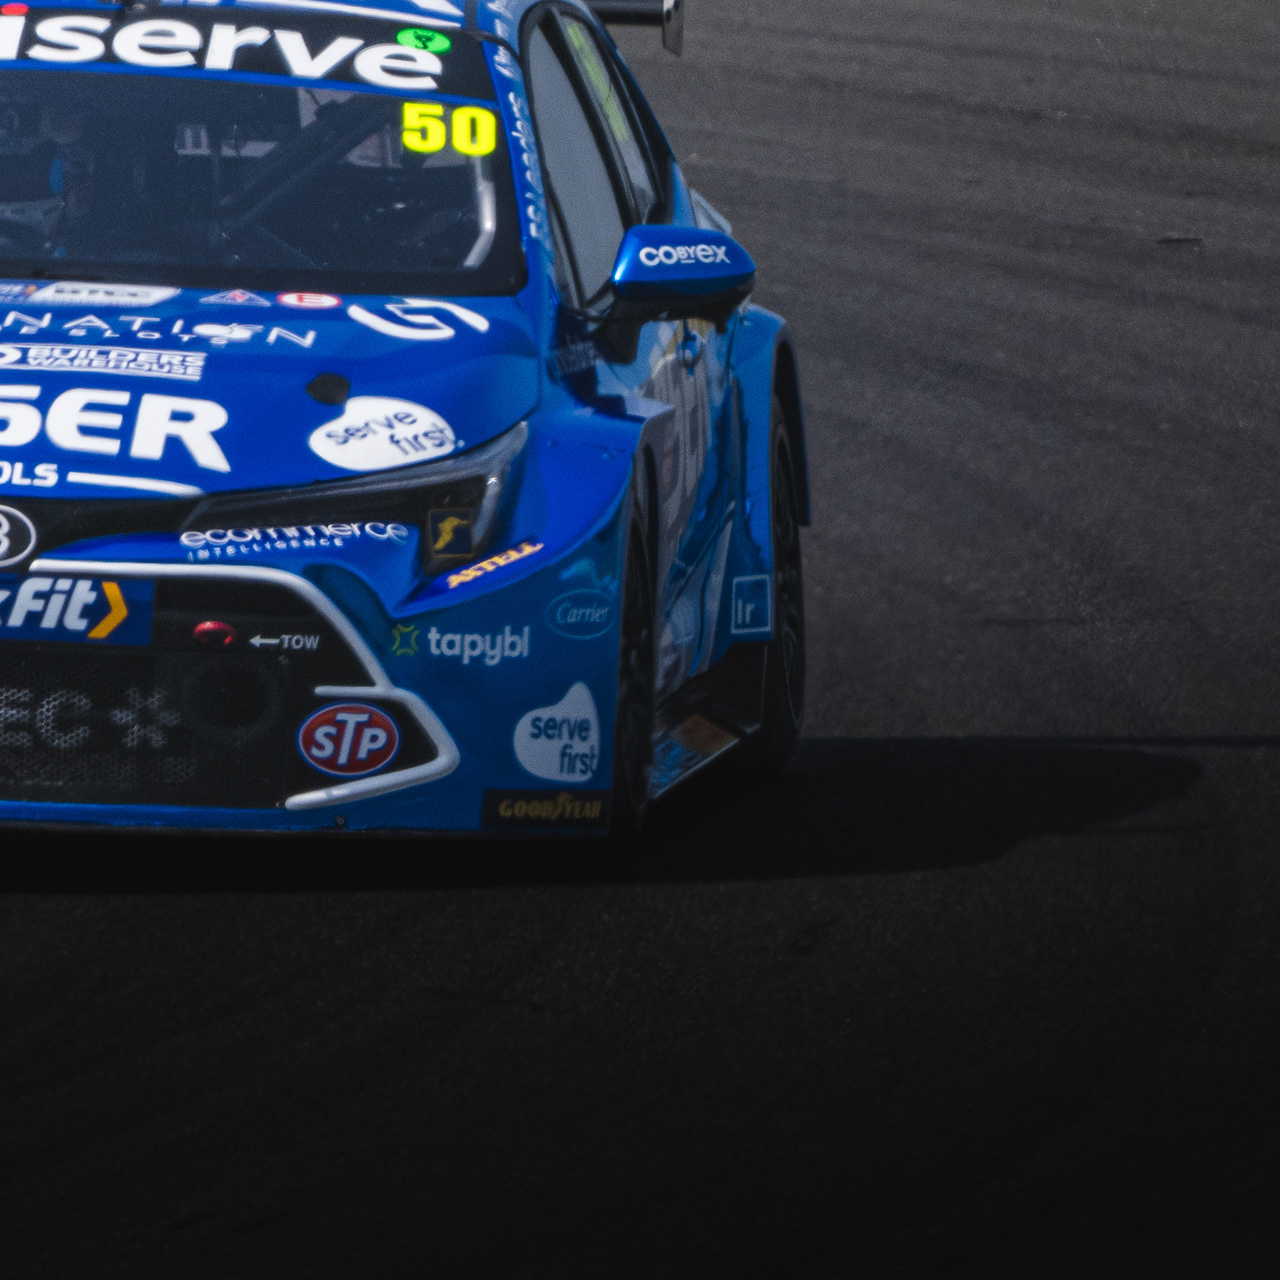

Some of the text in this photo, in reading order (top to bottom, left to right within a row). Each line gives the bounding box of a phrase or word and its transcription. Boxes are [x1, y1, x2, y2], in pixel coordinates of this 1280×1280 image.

[402, 102, 497, 156] 50
[68, 329, 230, 348] SLOTS
[27, 348, 205, 367] BUILDERS
[27, 357, 203, 376] WAREHOUSE
[325, 411, 418, 445] serve
[180, 522, 409, 549] ecommerce
[187, 537, 344, 561] INTELLIGENCE
[556, 602, 611, 624] Carrier
[280, 634, 320, 650] TOW
[428, 625, 531, 665] tapybl
[309, 712, 388, 767] STP
[530, 717, 590, 742] serve
